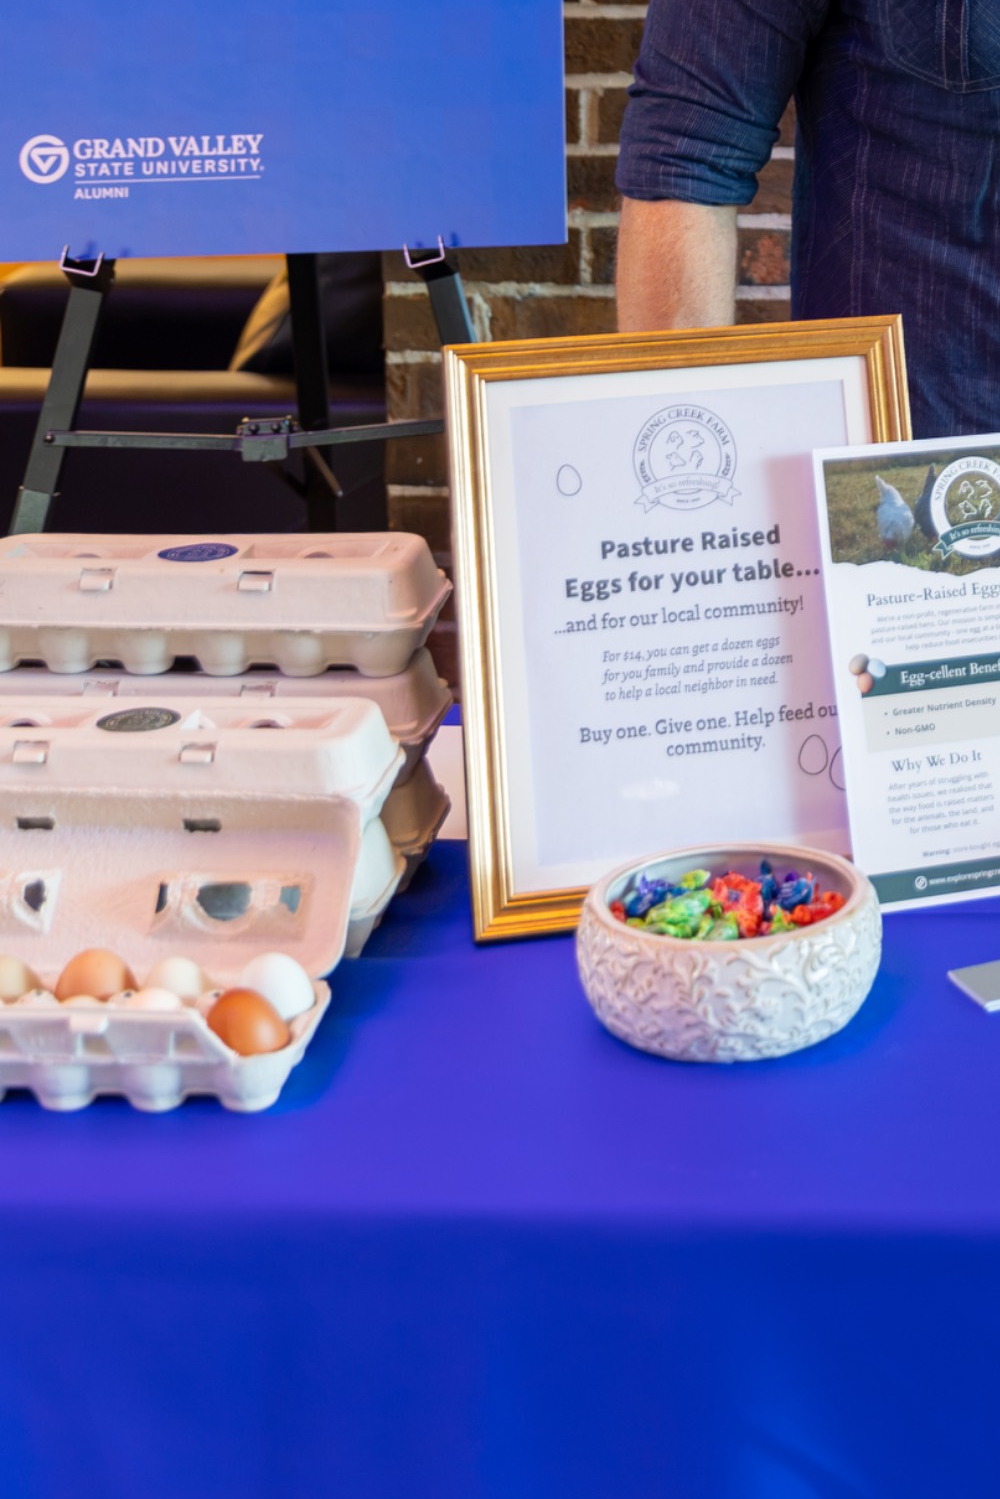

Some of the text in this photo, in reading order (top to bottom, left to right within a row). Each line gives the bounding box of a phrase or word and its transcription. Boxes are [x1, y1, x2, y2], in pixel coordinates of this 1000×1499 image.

[73, 134, 264, 160] GRAND VALLEY
[74, 162, 134, 178] STATE
[74, 187, 129, 200] ALUMNI
[638, 408, 730, 452] SPRING CREEK FARM
[935, 467, 959, 501] SPRING
[959, 459, 990, 471] CREEK
[600, 524, 781, 560] Pasture Raised
[565, 558, 821, 602] Eggs for your table...
[867, 582, 967, 606] Pasture-Raised
[601, 612, 626, 630] for
[629, 611, 658, 627] our
[662, 604, 701, 624] local
[704, 595, 804, 620] community!
[602, 651, 621, 663] For
[646, 648, 667, 662] you
[670, 645, 690, 656] can
[692, 642, 710, 657] get
[712, 643, 718, 651] a
[721, 638, 753, 652] dozen
[756, 636, 780, 650] eggs
[602, 653, 793, 685] for you family and provide a dozen
[901, 665, 967, 686] Egg-cellent
[605, 672, 778, 702] to help a local neighbor in need.
[893, 695, 997, 716] Greater Nutrient Density
[580, 702, 838, 745] Buy one. Give one. Help feed ou
[895, 722, 936, 736] Non-GMO
[666, 734, 766, 757] community.
[891, 749, 982, 773] Why We Do It
